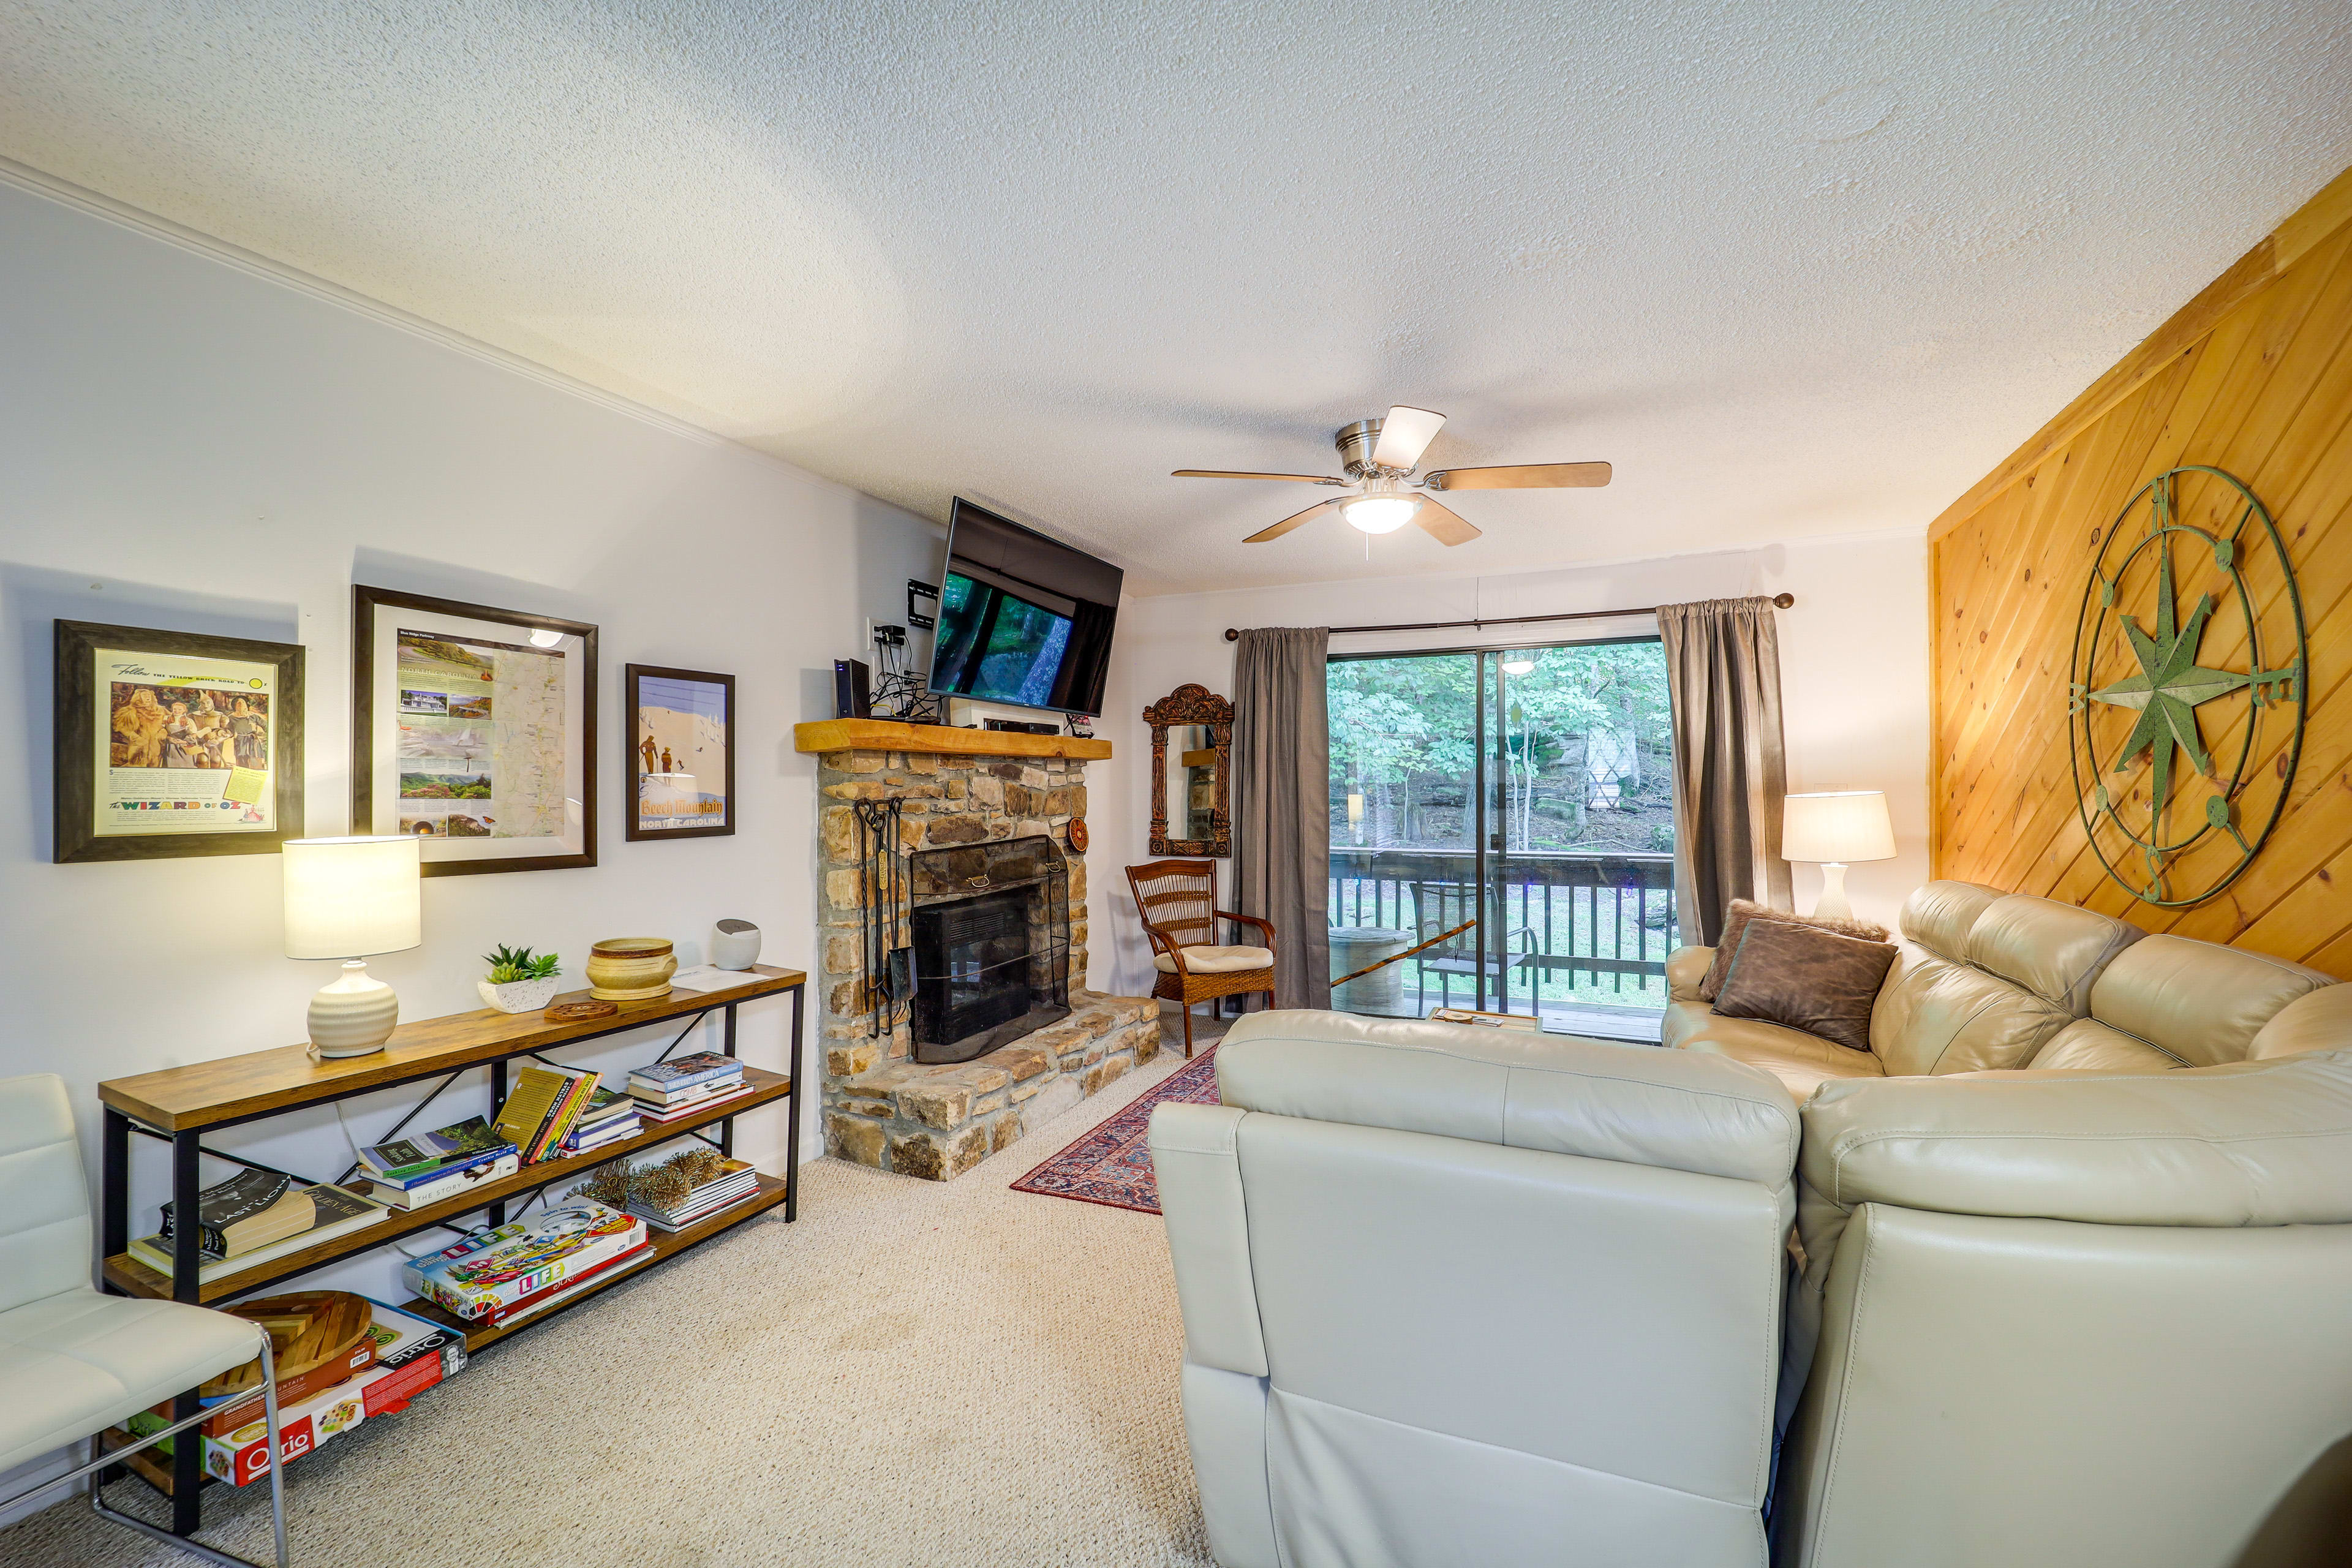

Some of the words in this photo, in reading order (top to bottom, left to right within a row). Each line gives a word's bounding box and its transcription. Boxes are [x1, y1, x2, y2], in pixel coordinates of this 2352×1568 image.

[111, 664, 150, 676] Follow
[435, 671, 478, 679] CAROLINA
[641, 799, 673, 818] Beech
[675, 798, 723, 818] Mountain
[641, 820, 676, 829] NORTH
[677, 818, 725, 827] CAROLINA
[693, 1070, 720, 1084] AMERICA
[556, 1082, 569, 1101] EVELYN
[562, 1086, 570, 1098] SEVEN
[547, 1102, 558, 1117] HUGO
[551, 1098, 564, 1117] HUSBANDS
[532, 1133, 541, 1147] JENKINS
[399, 1148, 416, 1158] Faith
[214, 1205, 252, 1223] LAST
[254, 1175, 291, 1206] LION
[417, 1191, 433, 1202] THE
[436, 1183, 461, 1196] STORY
[304, 1190, 341, 1210] GOLDEN
[340, 1204, 361, 1215] AGE
[540, 1209, 559, 1218] Spin
[447, 1226, 521, 1257] LIFE
[417, 1254, 447, 1268] Game
[522, 1264, 562, 1292] LIFE
[389, 1336, 446, 1363] Otrio
[277, 1376, 304, 1392] UNTAIN
[224, 1395, 265, 1415] GRANDFATHER
[247, 1434, 309, 1471] Orio
